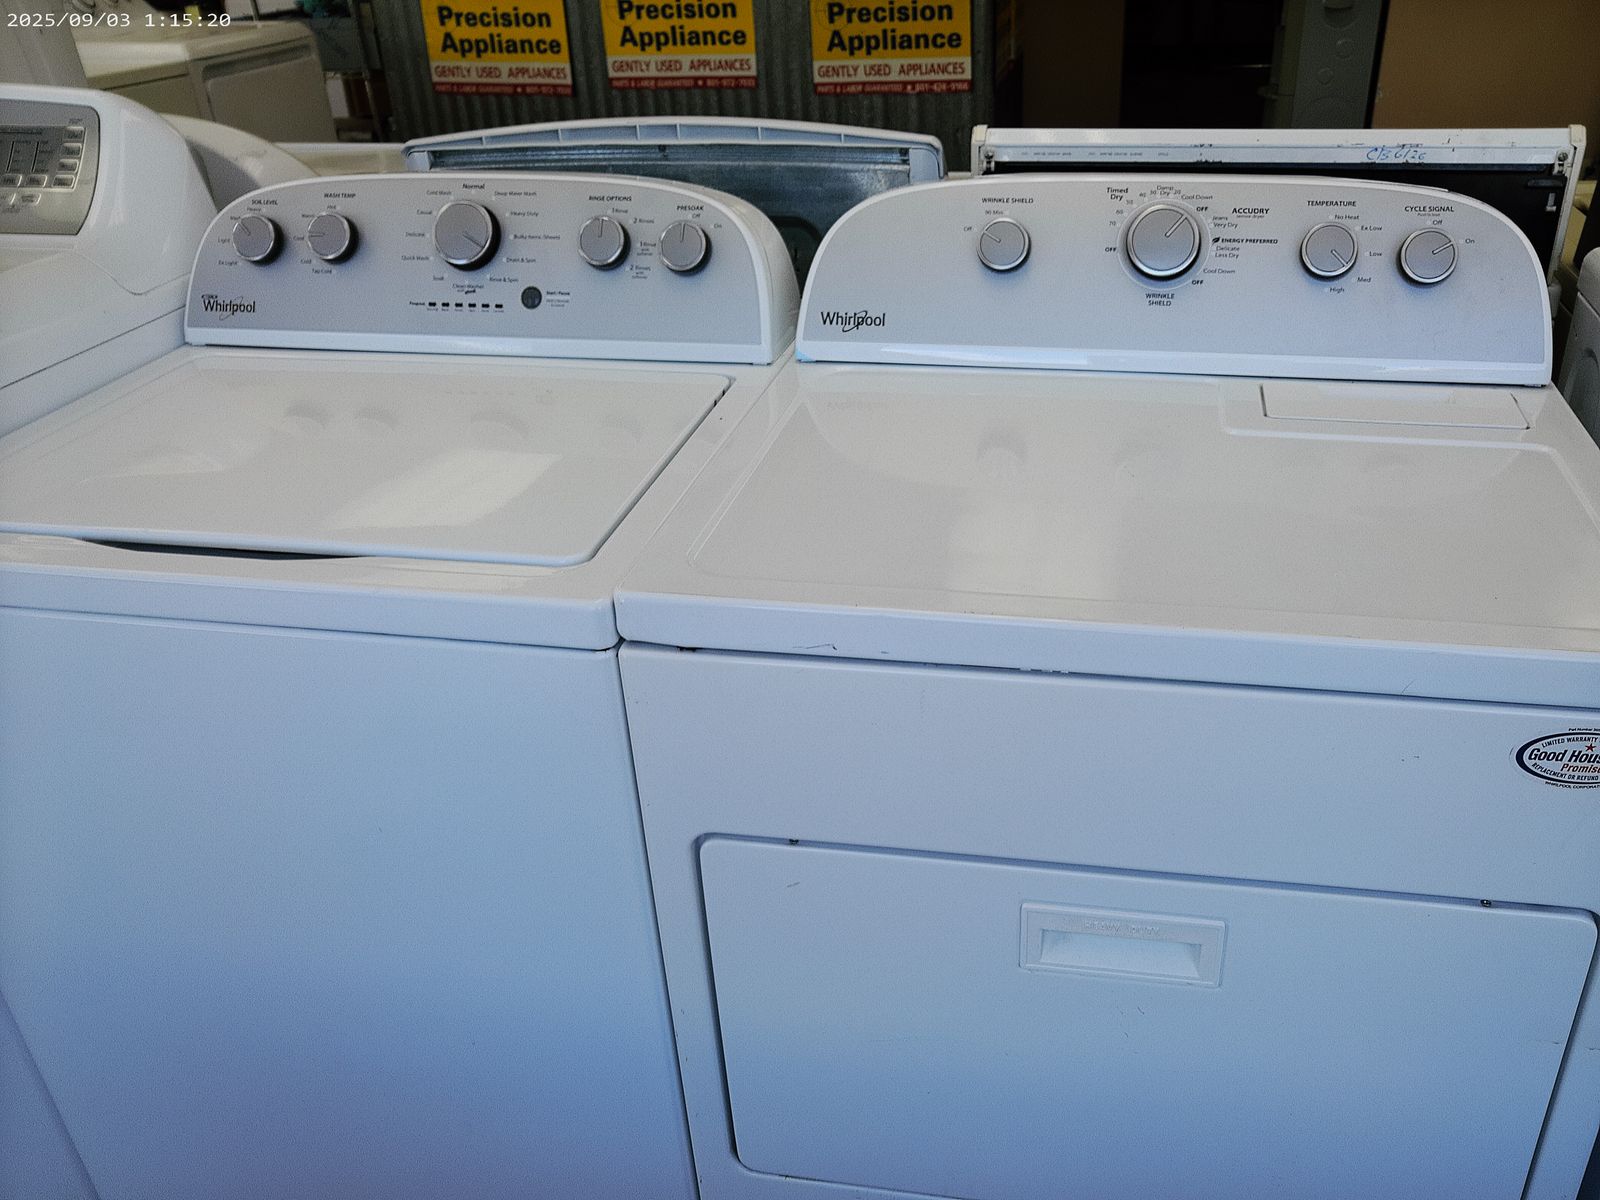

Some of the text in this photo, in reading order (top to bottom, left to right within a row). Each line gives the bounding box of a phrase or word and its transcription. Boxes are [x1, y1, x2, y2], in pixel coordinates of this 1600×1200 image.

[437, 6, 551, 28] Precision
[618, 0, 736, 20] Precision
[828, 1, 952, 23] Precision
[441, 32, 561, 58] Appliance
[620, 26, 747, 51] Appliance
[827, 29, 962, 56] Appliance
[434, 65, 567, 80] GENTLY USED APPLIANCES
[612, 58, 751, 73] GENTLY USED APPLIANCES
[817, 62, 964, 78] GENTLY USED APPLIANCES
[203, 300, 256, 316] Whirlpool
[821, 311, 886, 332] Whirlpool
[1542, 739, 1565, 748] LIMITED
[1528, 748, 1568, 762] Good
[1532, 762, 1567, 779] REPLACEMENT
